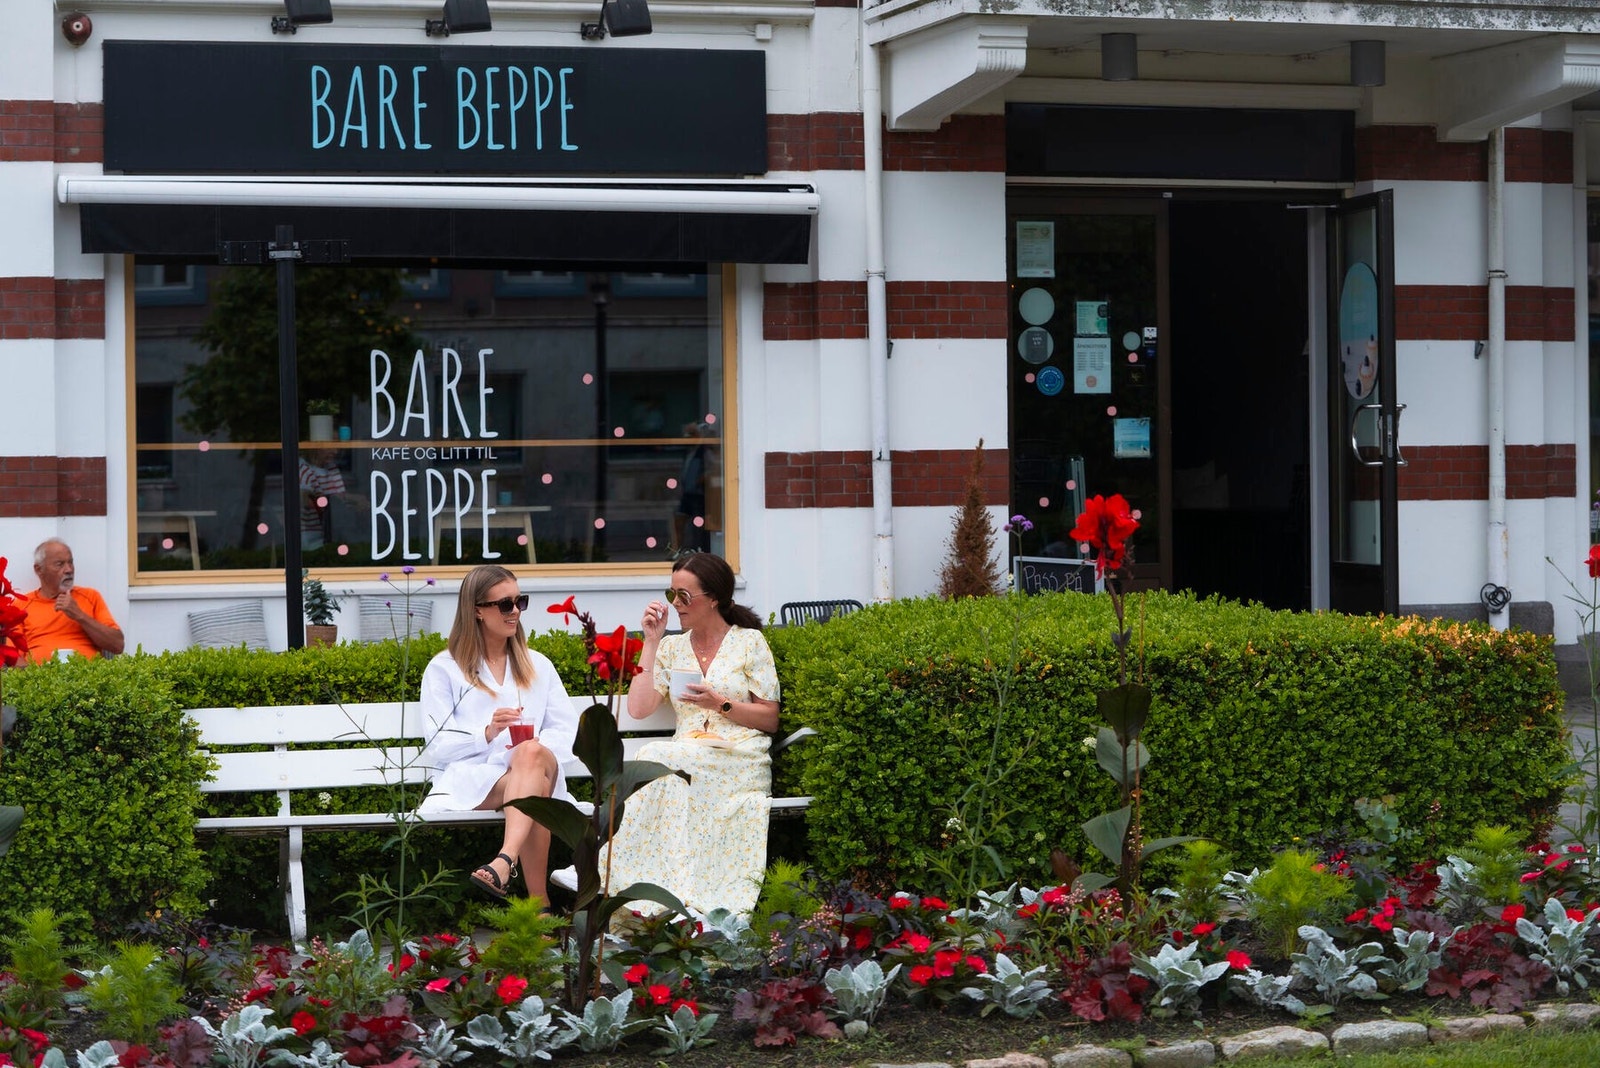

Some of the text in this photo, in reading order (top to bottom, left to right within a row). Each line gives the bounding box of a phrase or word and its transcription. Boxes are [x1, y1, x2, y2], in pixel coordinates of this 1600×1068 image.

[311, 65, 579, 151] BARE BEPPE
[370, 348, 499, 439] BARE
[371, 445, 497, 460] KAFÉ OG LITT TIL
[370, 468, 502, 561] BEPPE
